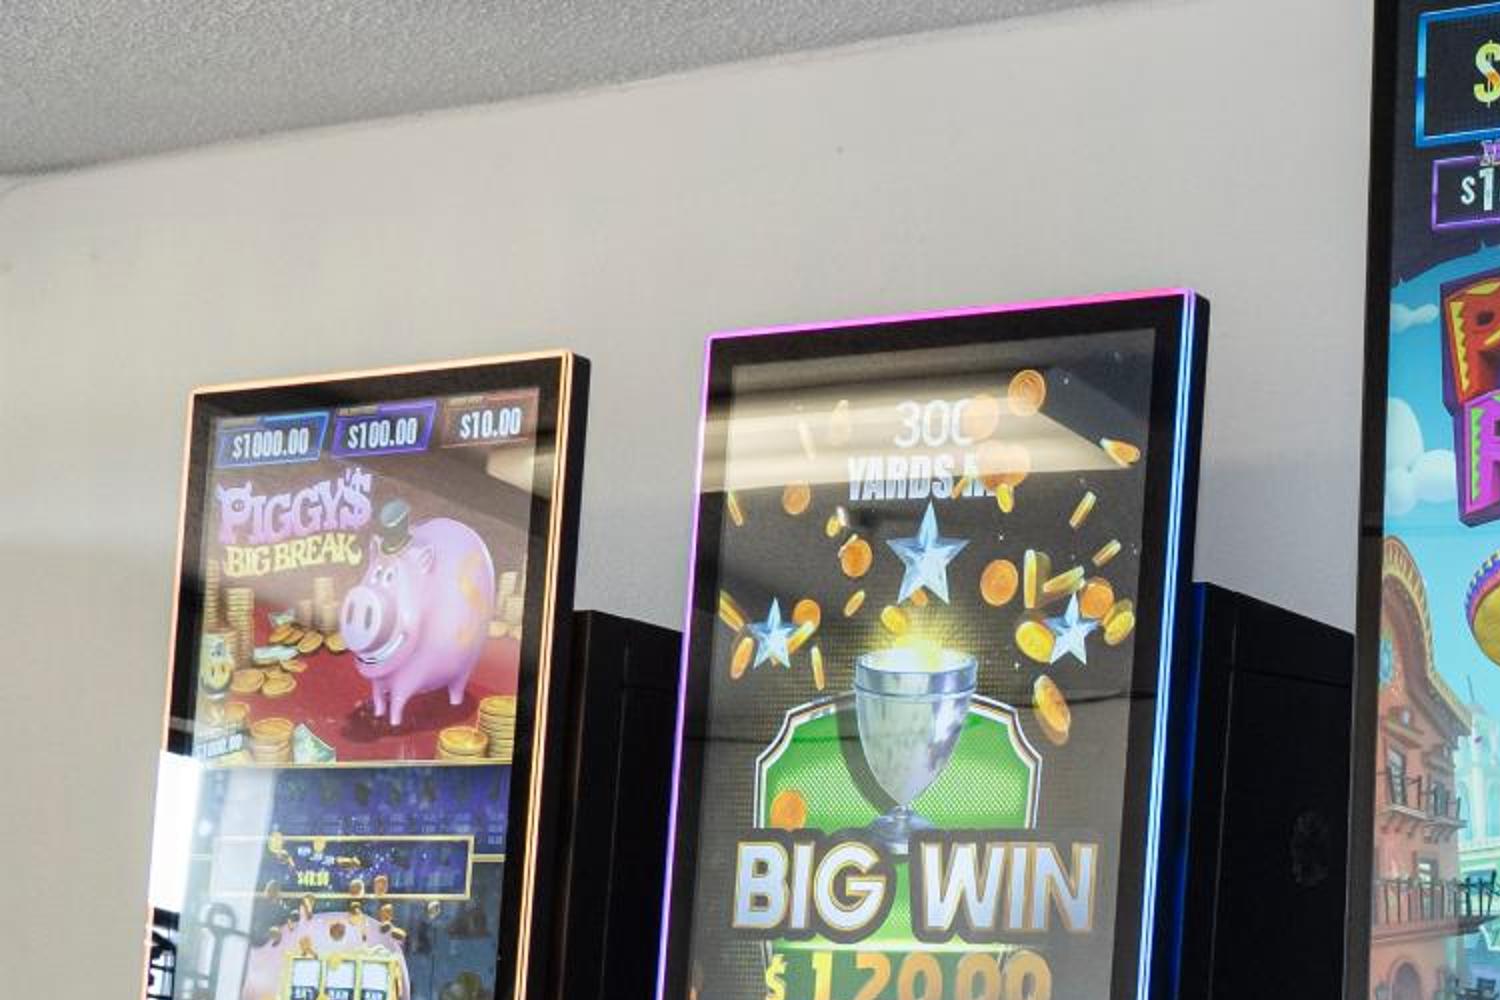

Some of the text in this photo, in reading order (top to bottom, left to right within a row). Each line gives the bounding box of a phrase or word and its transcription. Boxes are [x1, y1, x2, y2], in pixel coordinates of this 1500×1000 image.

[231, 407, 521, 460] $1000.00 $100.00 $10.00
[848, 454, 954, 501] YARDS
[223, 532, 363, 577] BIG BREAK
[732, 841, 1099, 932] BIG WIN
